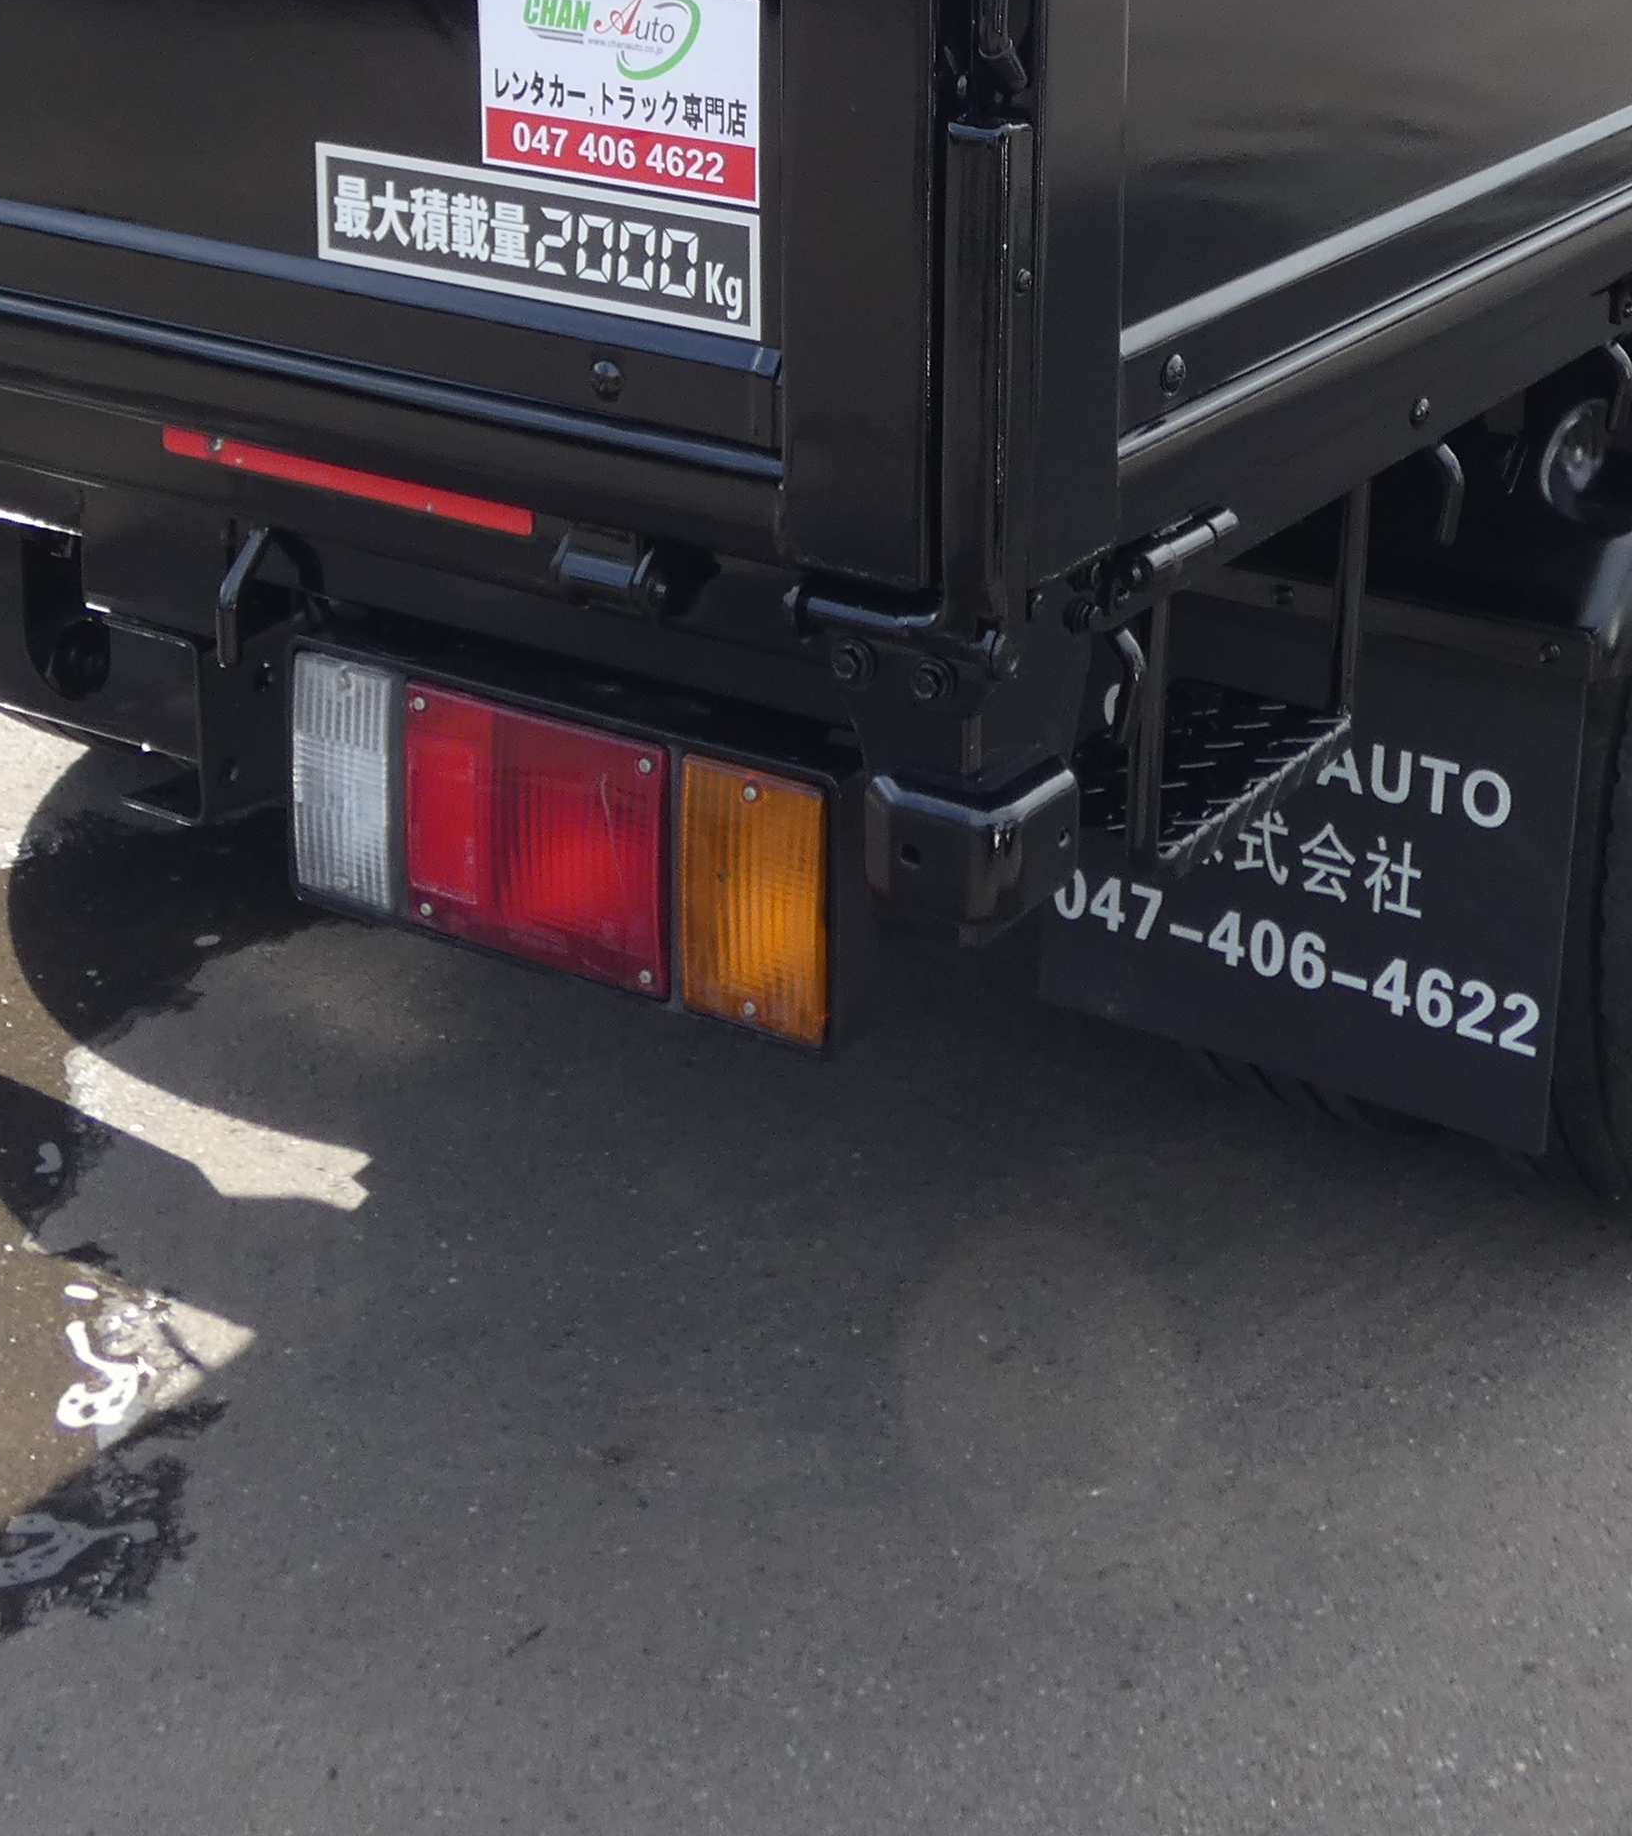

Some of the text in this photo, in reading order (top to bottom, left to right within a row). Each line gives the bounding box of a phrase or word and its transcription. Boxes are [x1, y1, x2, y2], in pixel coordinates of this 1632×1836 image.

[512, 121, 725, 184] 047 406 4622
[1202, 810, 1423, 919] 式会社
